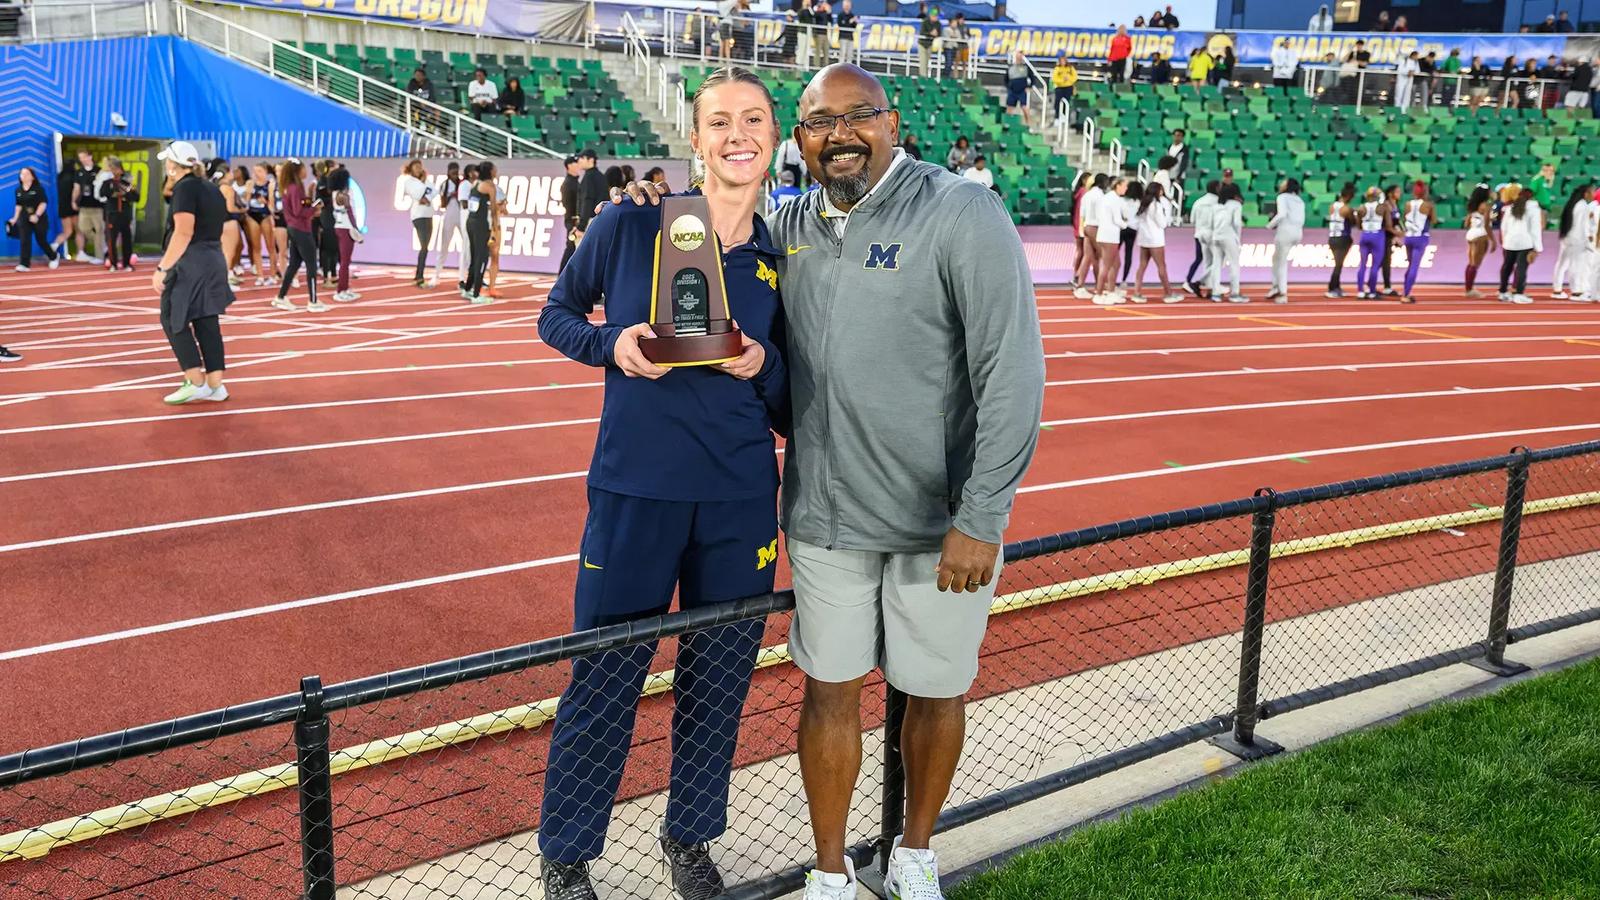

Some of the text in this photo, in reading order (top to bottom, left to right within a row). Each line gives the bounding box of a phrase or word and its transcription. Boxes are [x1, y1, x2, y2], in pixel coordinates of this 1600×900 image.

[866, 24, 916, 51] AND
[498, 217, 554, 257] ERE
[673, 232, 704, 243] NCAA
[863, 242, 903, 271] M
[756, 258, 777, 290] M
[757, 538, 778, 570] M
